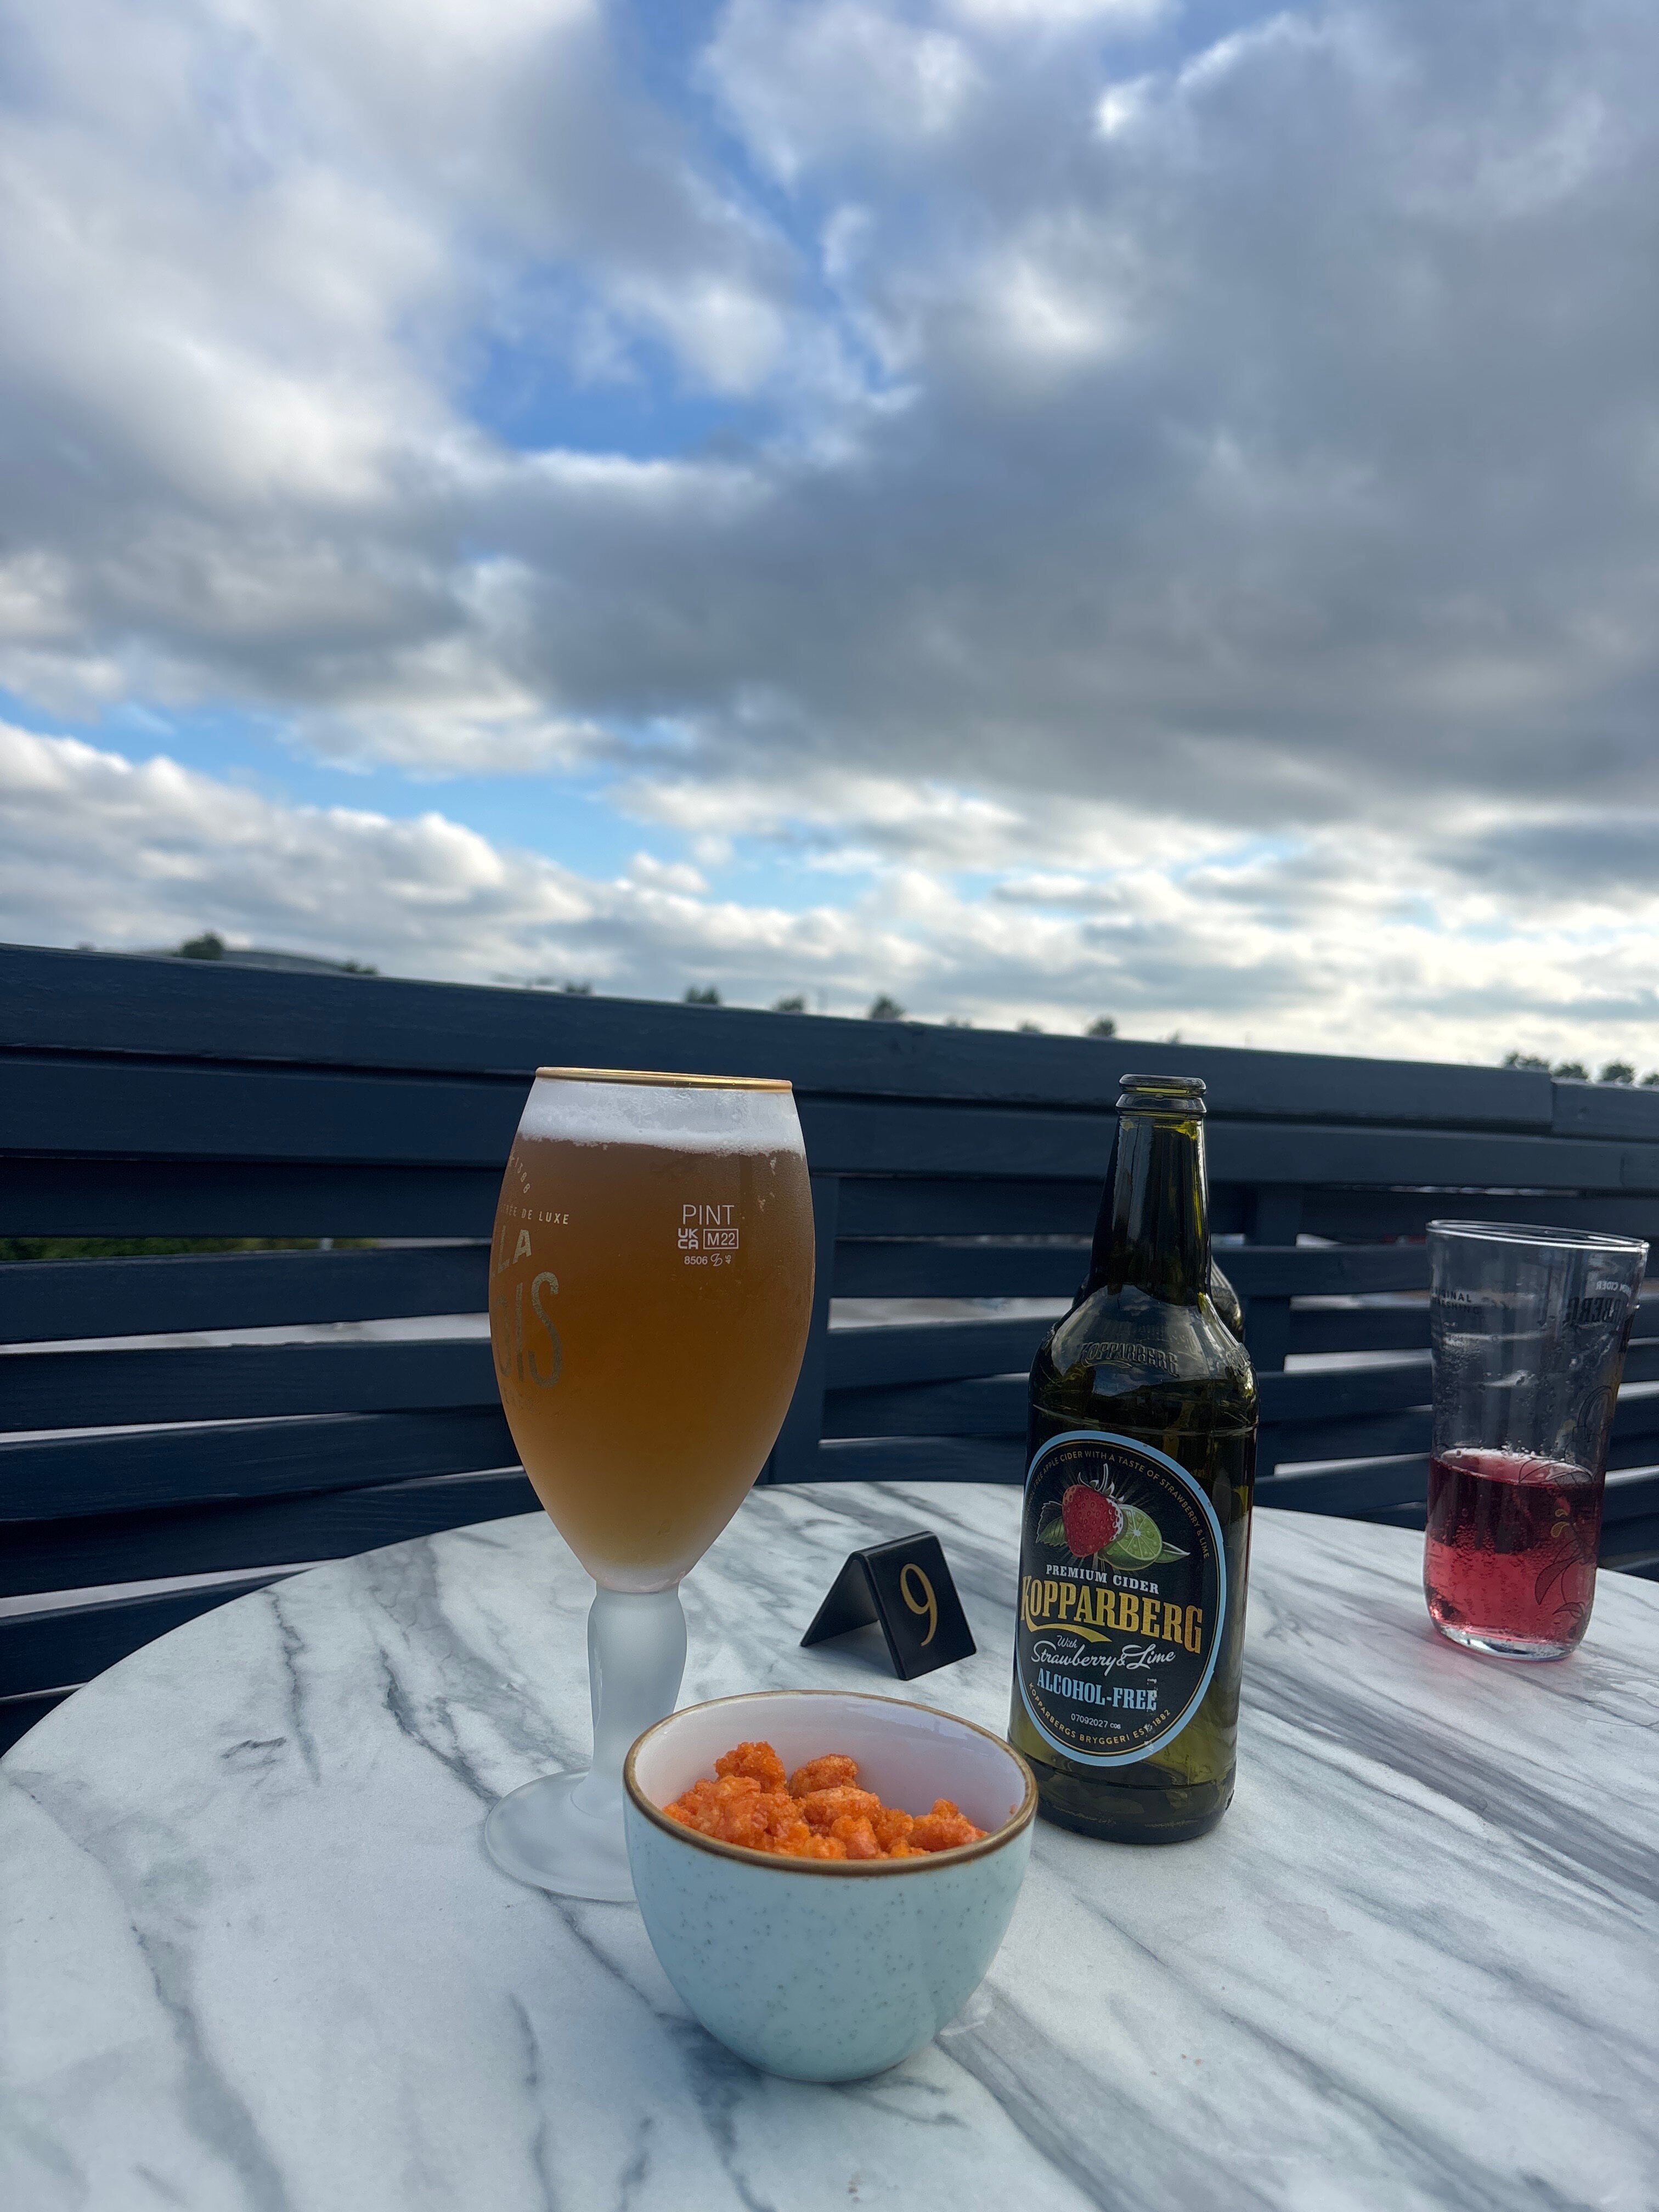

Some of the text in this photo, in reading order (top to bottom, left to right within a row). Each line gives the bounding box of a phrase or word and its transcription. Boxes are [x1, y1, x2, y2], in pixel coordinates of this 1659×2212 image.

[521, 1208, 533, 1221] DE
[539, 1211, 569, 1225] LUXE
[682, 1204, 735, 1225] PINT
[678, 1228, 736, 1246] UK M22
[678, 1239, 699, 1250] CA
[684, 1255, 708, 1265] 8506
[1043, 1457, 1059, 1474] APPLE
[1060, 1451, 1083, 1462] CIDER
[1084, 1451, 1107, 1460] WITH
[1108, 1454, 1115, 1462] A
[1118, 1456, 1146, 1472] TASTE
[1147, 1470, 1160, 1481] OF
[1159, 1479, 1200, 1527] STRAWBERRY
[1199, 1537, 1210, 1559] LIME
[1046, 1564, 1159, 1594] PREMIUM CIDER
[899, 1563, 938, 1646] 9
[1021, 1576, 1203, 1654] KOPPARBERG
[1057, 1635, 1079, 1649] With
[1036, 1667, 1157, 1711] ALCOHOL-FREE
[1029, 1682, 1076, 1738] KOPPARBERGS
[1079, 1733, 1130, 1745] BRYGGERI
[1152, 1709, 1171, 1727] 1882
[1070, 1713, 1109, 1728] 07092027
